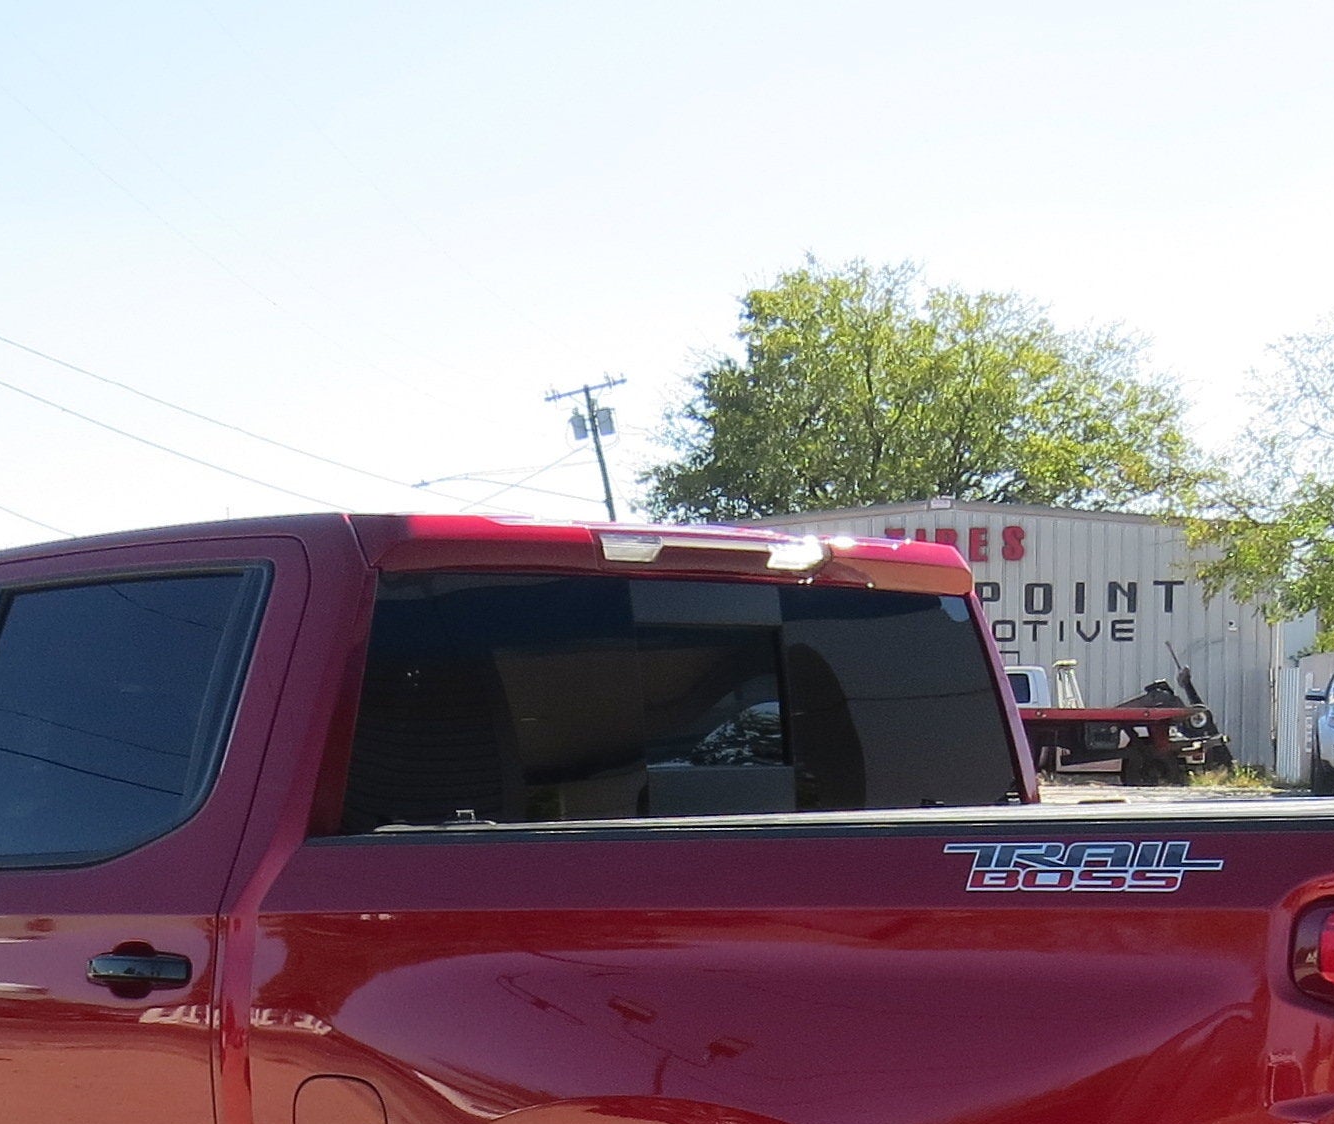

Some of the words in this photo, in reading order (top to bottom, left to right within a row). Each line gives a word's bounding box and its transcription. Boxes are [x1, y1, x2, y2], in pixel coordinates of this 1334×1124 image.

[974, 579, 1185, 614] POINT
[942, 841, 1224, 870] TRAIL
[966, 867, 1184, 892] BOSS
